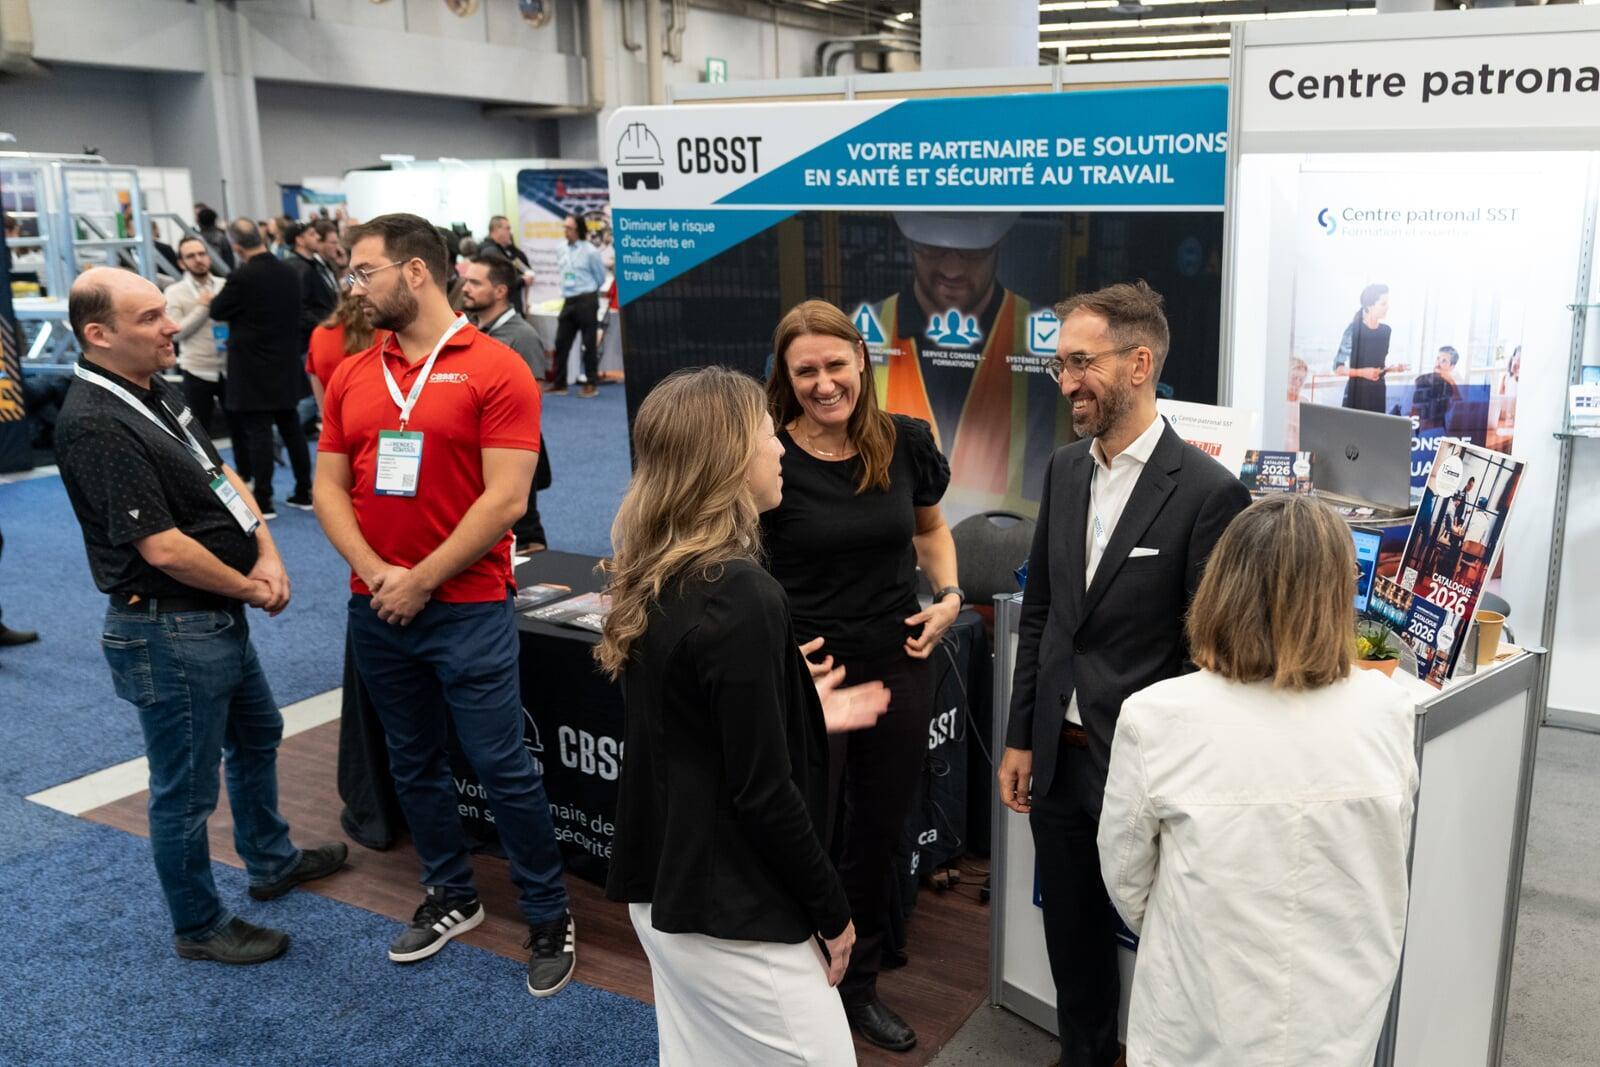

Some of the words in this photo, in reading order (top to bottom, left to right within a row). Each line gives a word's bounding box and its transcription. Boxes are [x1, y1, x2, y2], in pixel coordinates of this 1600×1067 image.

[1269, 68, 1406, 100] Centre
[1422, 63, 1600, 103] patrona
[677, 136, 762, 174] CBSST
[847, 142, 913, 161] VOTRE
[919, 138, 1049, 160] PARTENAIRE
[1056, 138, 1086, 157] DE
[1093, 132, 1228, 156] SOLUTIONS
[804, 168, 831, 186] EN
[836, 164, 900, 186] SANTÉ
[906, 168, 929, 186] ET
[935, 163, 1034, 186] SÉCURITÉ
[1040, 166, 1073, 185] AU
[1079, 164, 1175, 184] TRAVAIL
[1342, 207, 1401, 222] Centre
[1406, 207, 1480, 224] patronal
[1486, 207, 1518, 222] SST
[619, 217, 667, 231] Diminuer
[669, 218, 679, 231] le
[682, 220, 715, 235] risque
[621, 235, 679, 249] d'accidents
[681, 238, 695, 249] en
[623, 252, 653, 265] milieu
[656, 252, 670, 265] de
[624, 268, 655, 282] travail
[922, 350, 949, 358] SERVICE
[949, 352, 981, 361] CONSEILS
[1261, 465, 1291, 476] 2026
[1432, 573, 1473, 598] CATALOGUE
[1425, 582, 1469, 617] 2026
[1408, 619, 1436, 642] 2026
[558, 725, 625, 781] CBS
[458, 804, 479, 819] en
